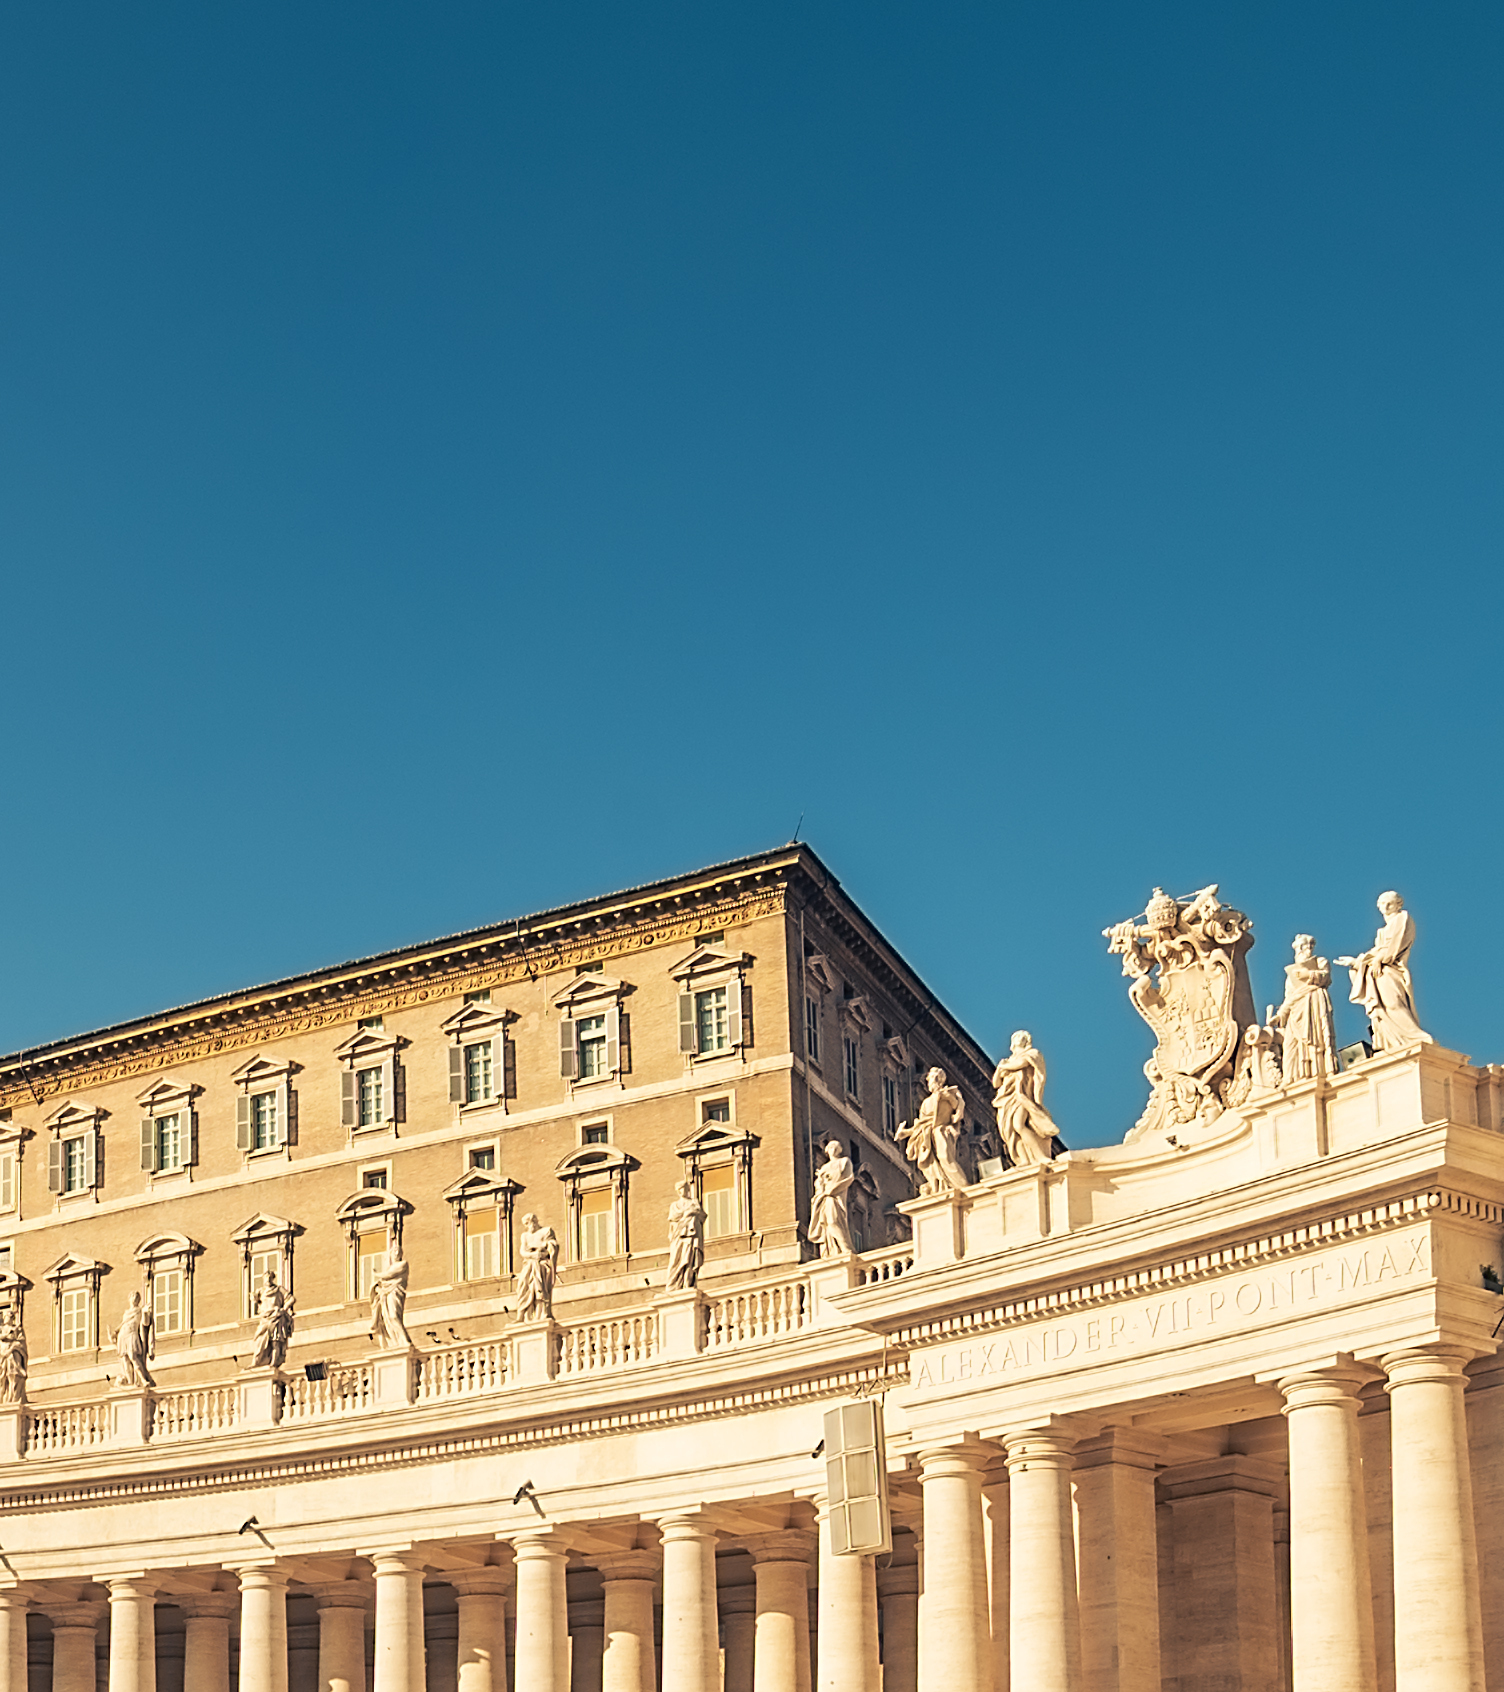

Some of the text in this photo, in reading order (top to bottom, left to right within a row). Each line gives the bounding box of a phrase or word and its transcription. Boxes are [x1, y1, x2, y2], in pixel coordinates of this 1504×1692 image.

[915, 1235, 1429, 1390] ALEXANDER VII PONT MAX
